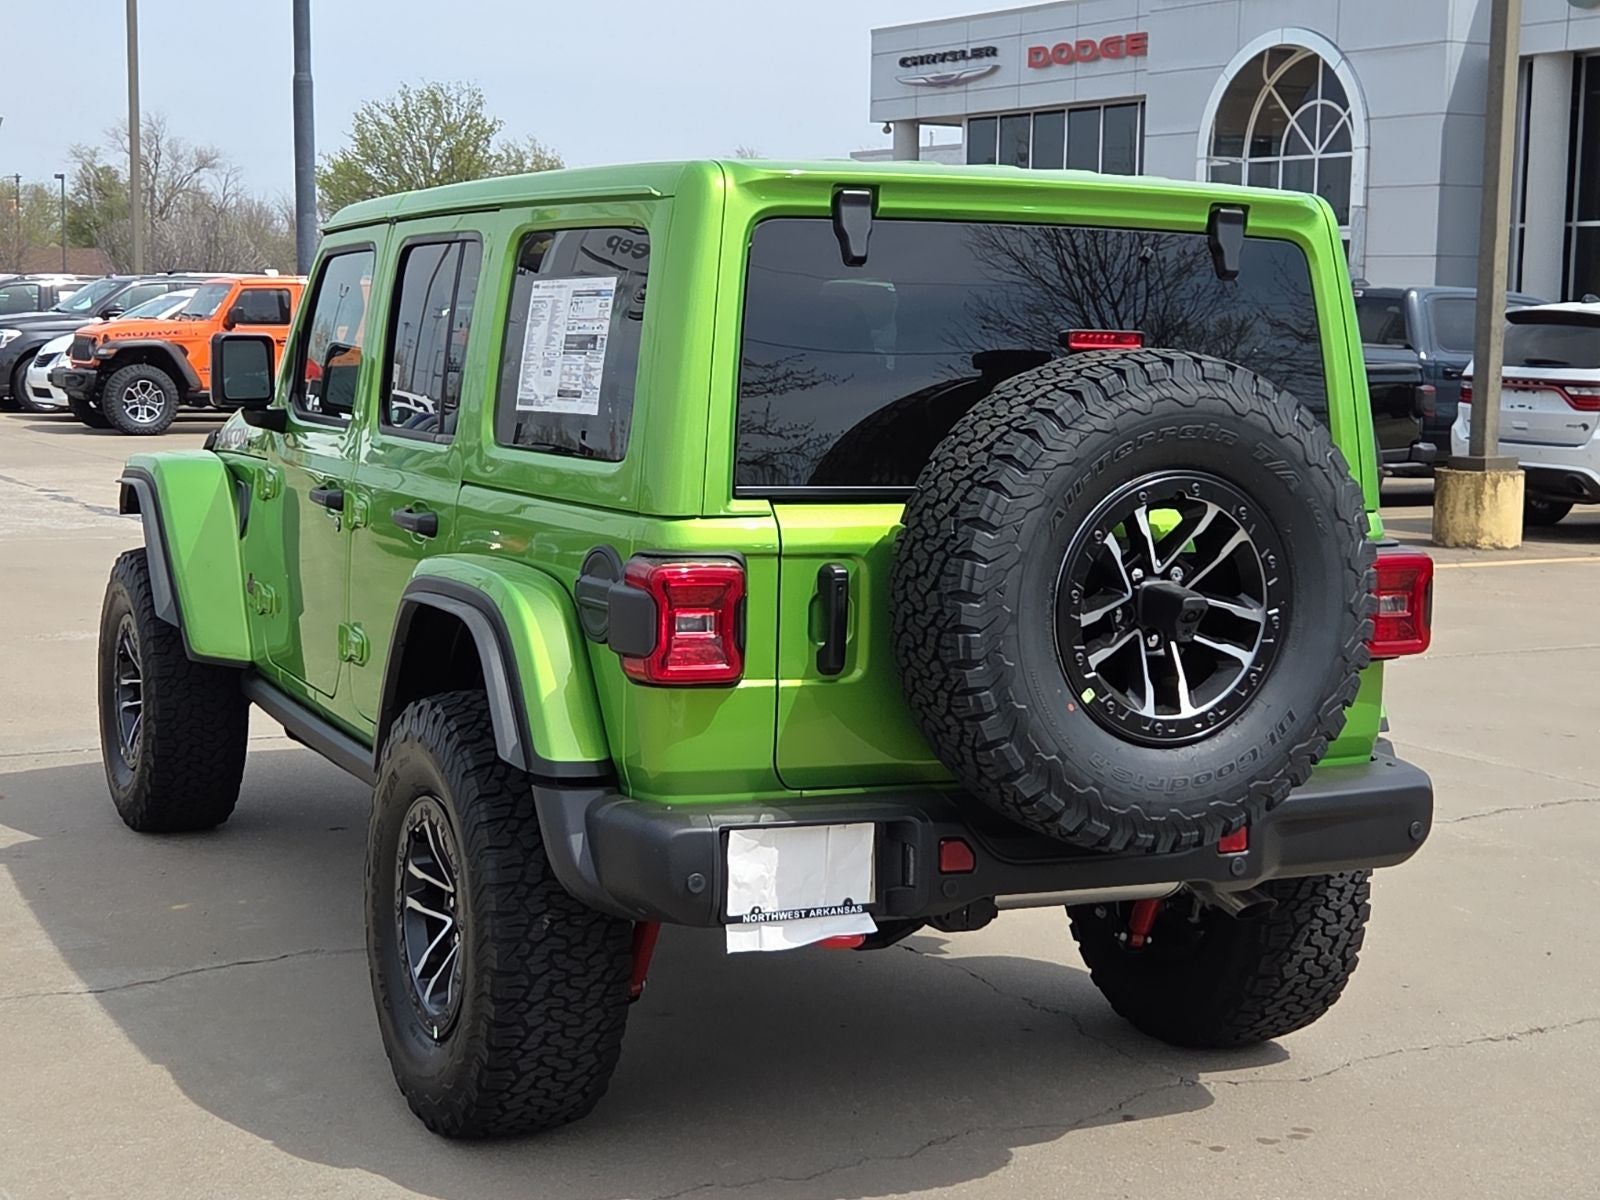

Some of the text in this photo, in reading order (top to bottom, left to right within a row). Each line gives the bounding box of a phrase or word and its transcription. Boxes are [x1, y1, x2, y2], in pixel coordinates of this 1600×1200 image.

[899, 46, 998, 68] CHRYSLER
[1028, 32, 1148, 69] DODGE
[742, 905, 863, 923] NORTHWEST ARKANSAS
